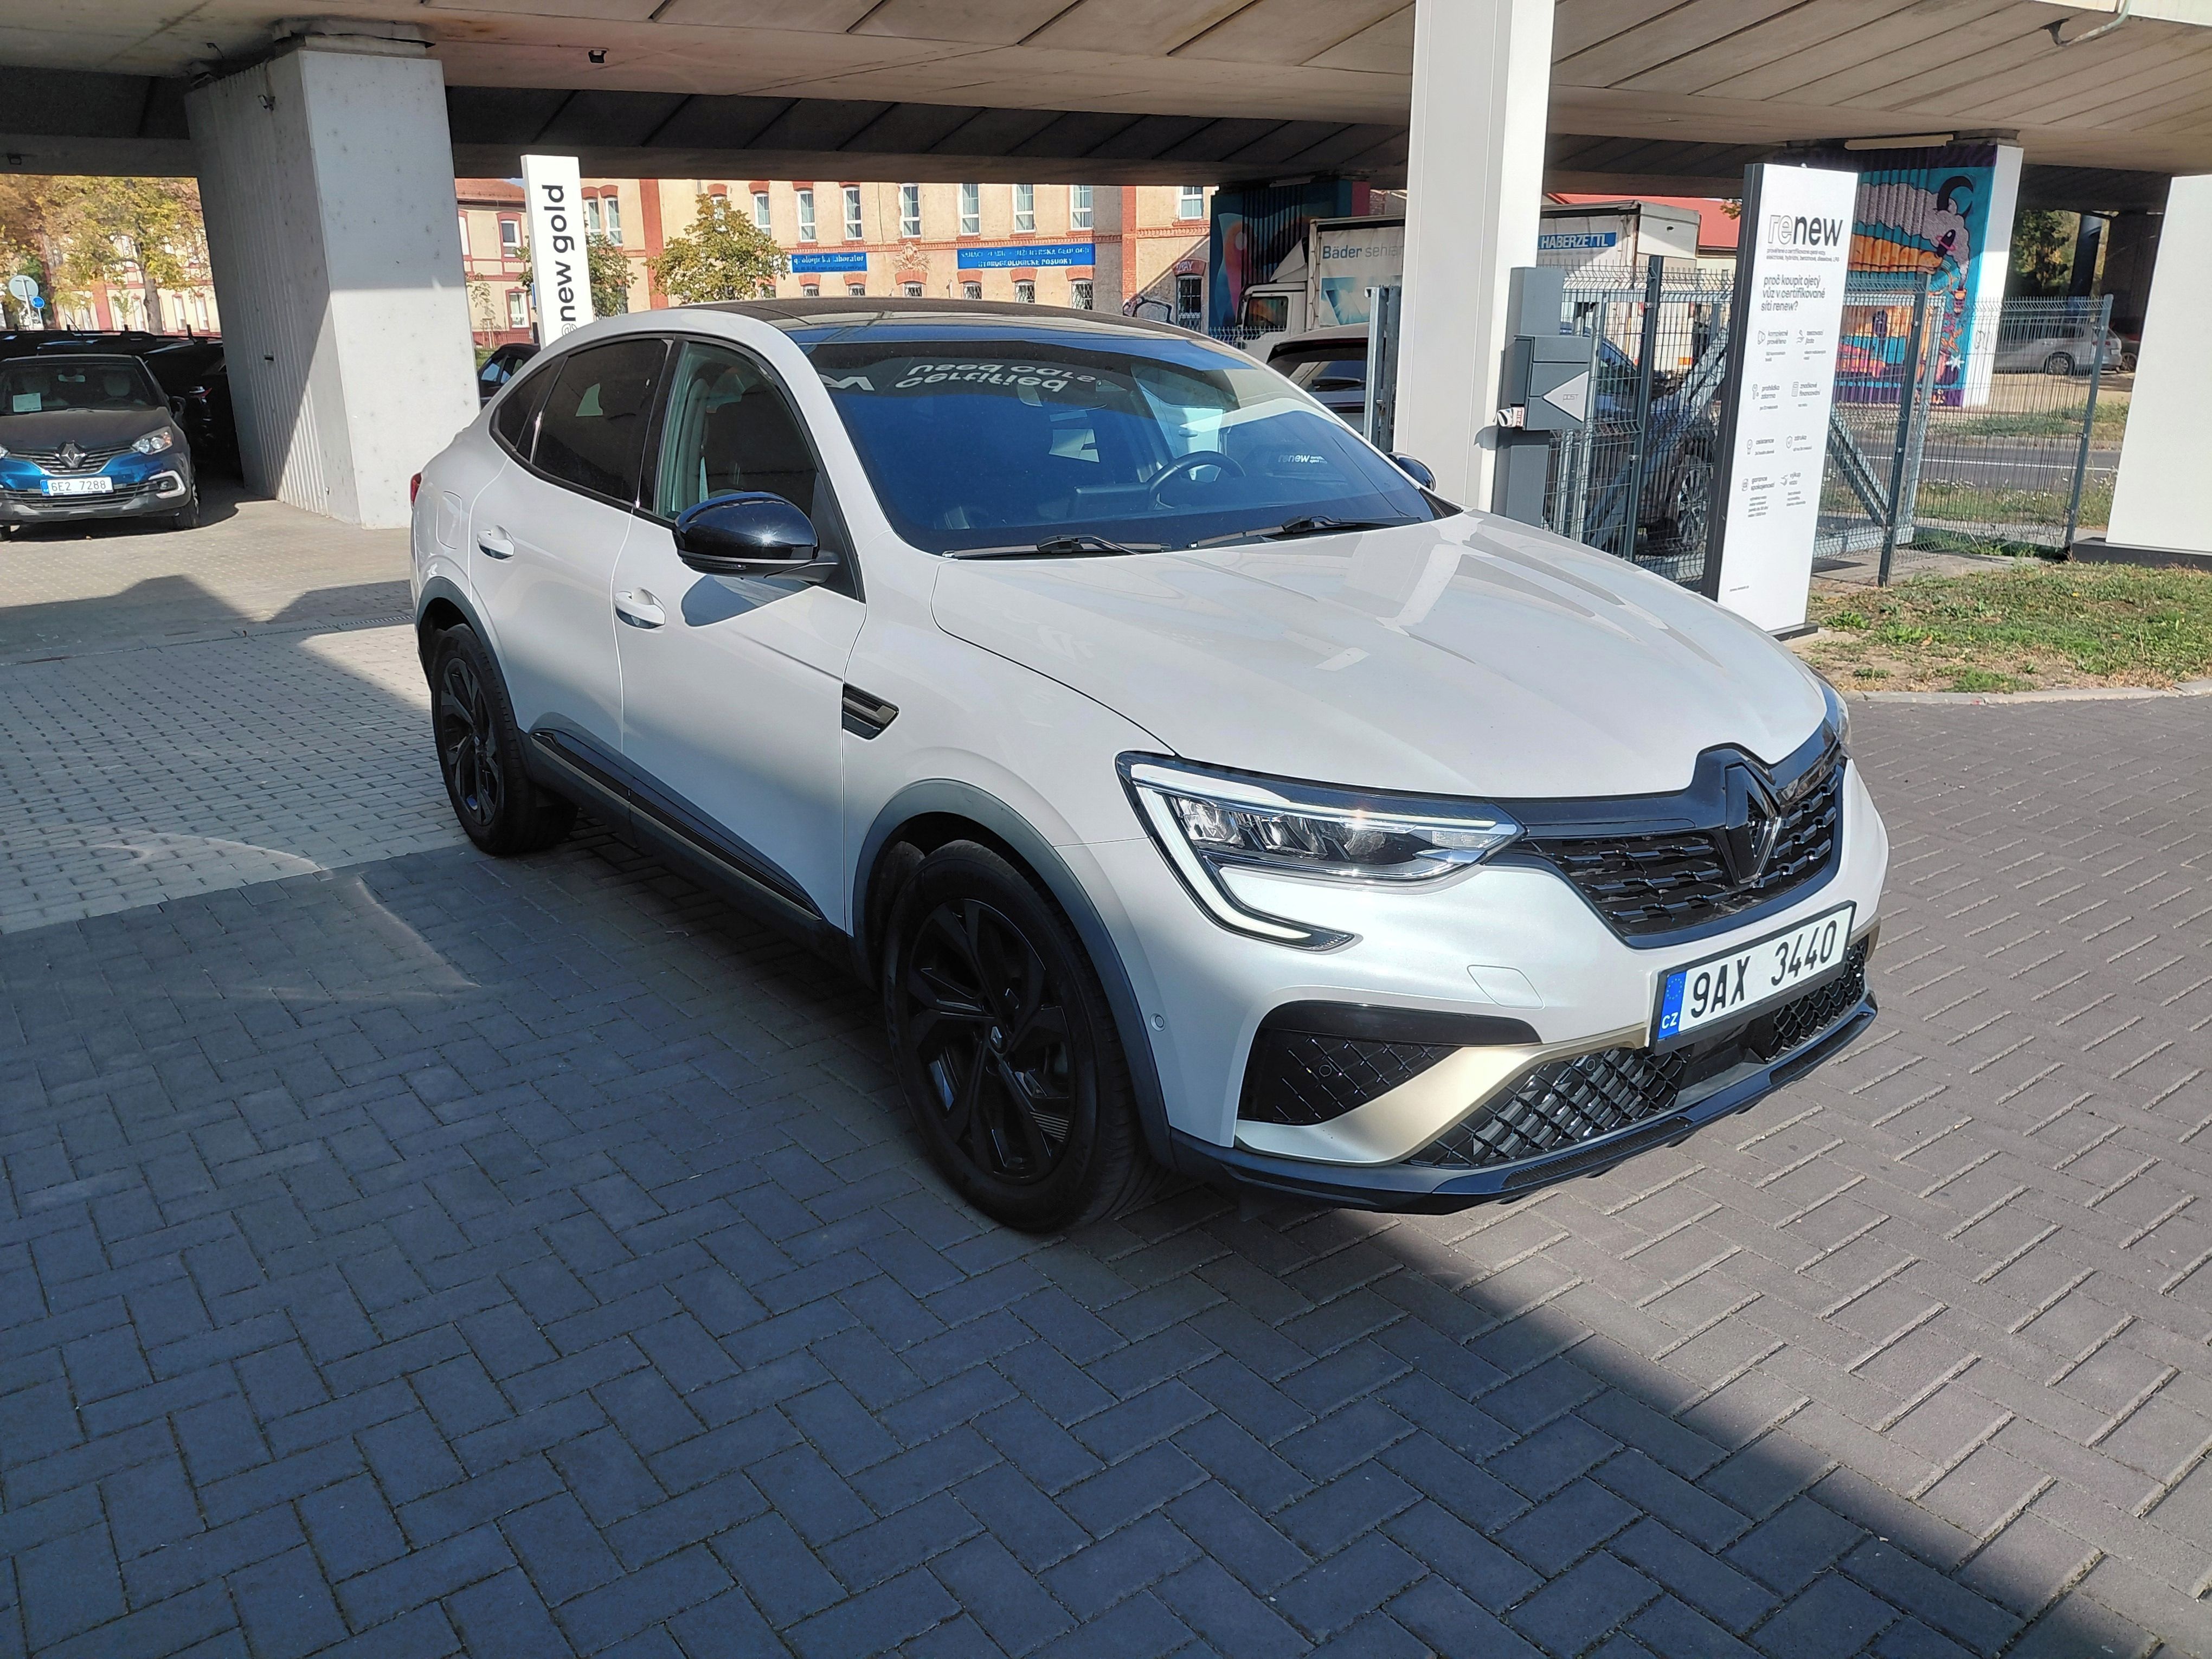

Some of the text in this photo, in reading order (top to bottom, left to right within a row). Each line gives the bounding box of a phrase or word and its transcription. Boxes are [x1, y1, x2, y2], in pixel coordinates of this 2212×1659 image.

[542, 185, 575, 253] gold
[1767, 215, 1843, 247] renew
[1541, 234, 1608, 249] HABERZETTL
[1322, 245, 1362, 259] Bäder
[1764, 274, 1821, 288] proč koupit ojetý
[1763, 287, 1825, 299] vůz v certifikované
[1773, 301, 1798, 311] renew?
[51, 480, 106, 491] 6E2 7288
[1690, 920, 1837, 1019] 9AX 3440
[1661, 1012, 1679, 1030] CZ
